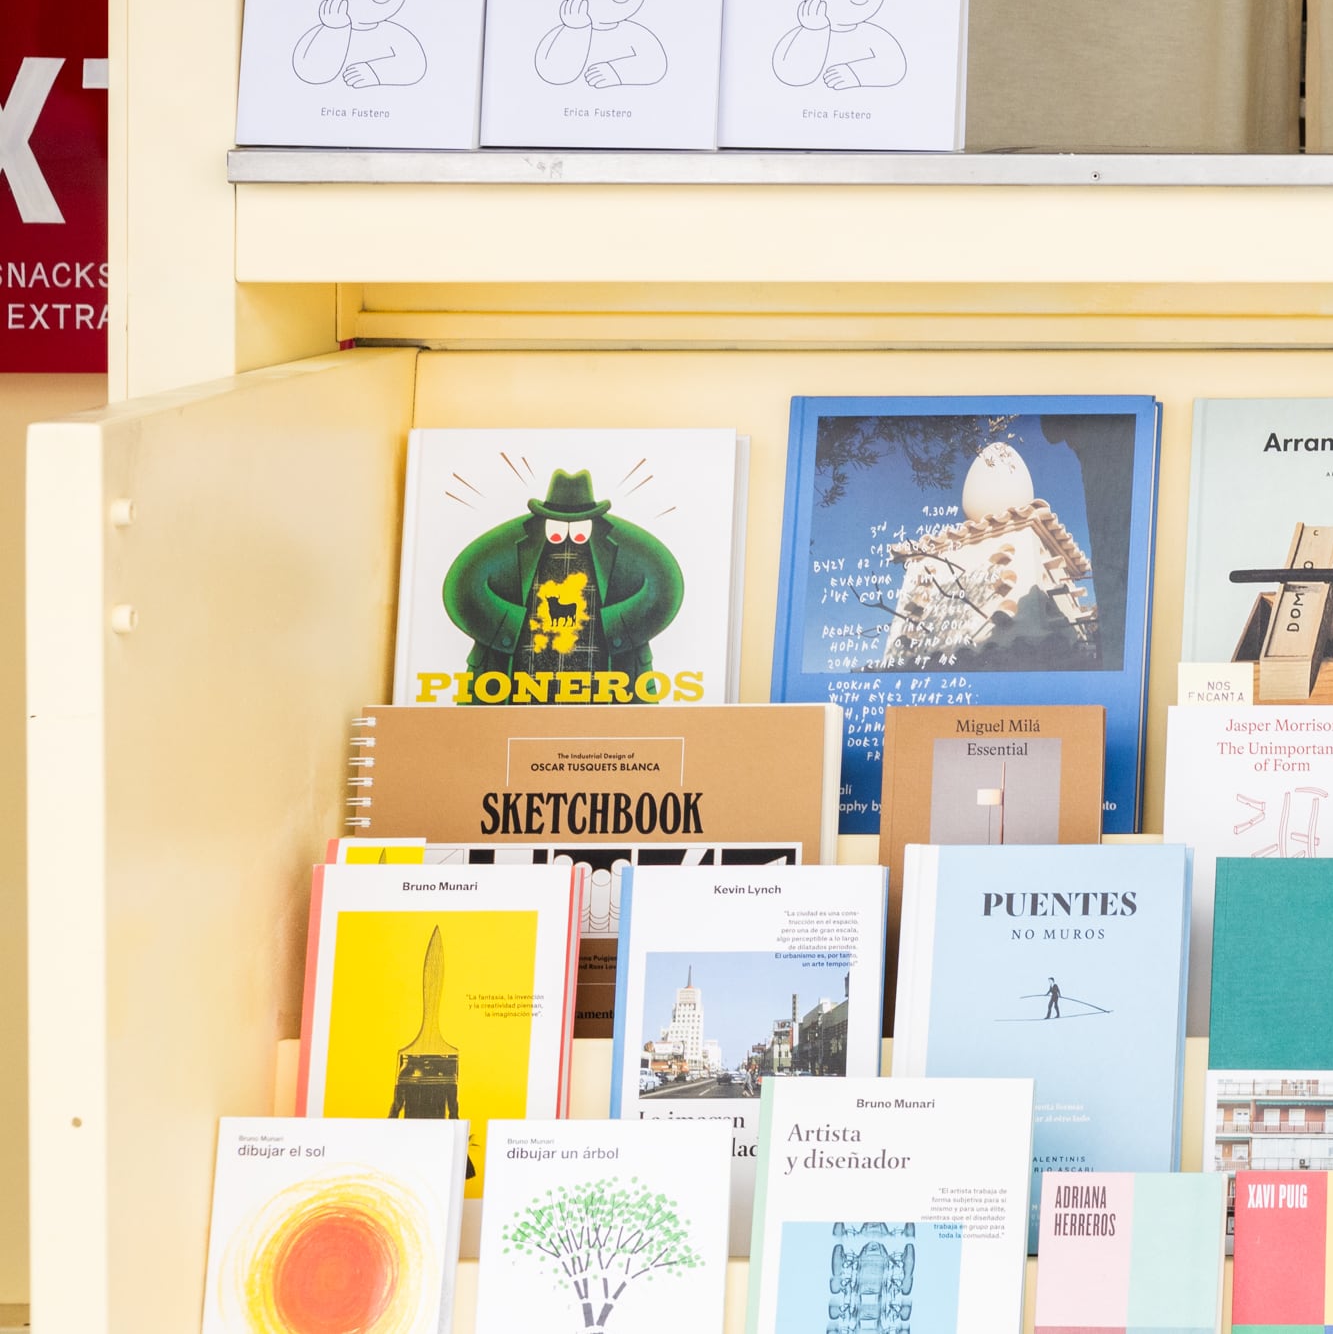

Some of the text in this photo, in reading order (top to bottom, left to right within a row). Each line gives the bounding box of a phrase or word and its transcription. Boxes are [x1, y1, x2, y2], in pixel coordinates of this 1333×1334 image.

[321, 107, 389, 118] Erica Fustero
[417, 671, 704, 704] PIONEROS
[956, 719, 1040, 735] Miguel Milá
[1226, 719, 1271, 735] Jasper
[968, 743, 1027, 755] Essential
[1217, 742, 1244, 754] The
[530, 763, 659, 772] OSCAR TUSQUETS BLANCA
[1254, 758, 1310, 772] of Form
[481, 792, 703, 835] SKETCHBOOK
[403, 882, 477, 890] Bruno Munari
[714, 885, 781, 895] Kevin Lynch
[984, 892, 1136, 916] PUENTES
[1012, 929, 1104, 939] NO MUROS
[788, 1124, 860, 1142] Artista
[238, 1145, 325, 1158] dibujar el sol
[507, 1147, 618, 1161] dibujar un árbol
[1055, 1186, 1106, 1208] ADRIANA
[1248, 1184, 1307, 1208] XAVI PUIG
[1054, 1213, 1116, 1236] HERREROS
